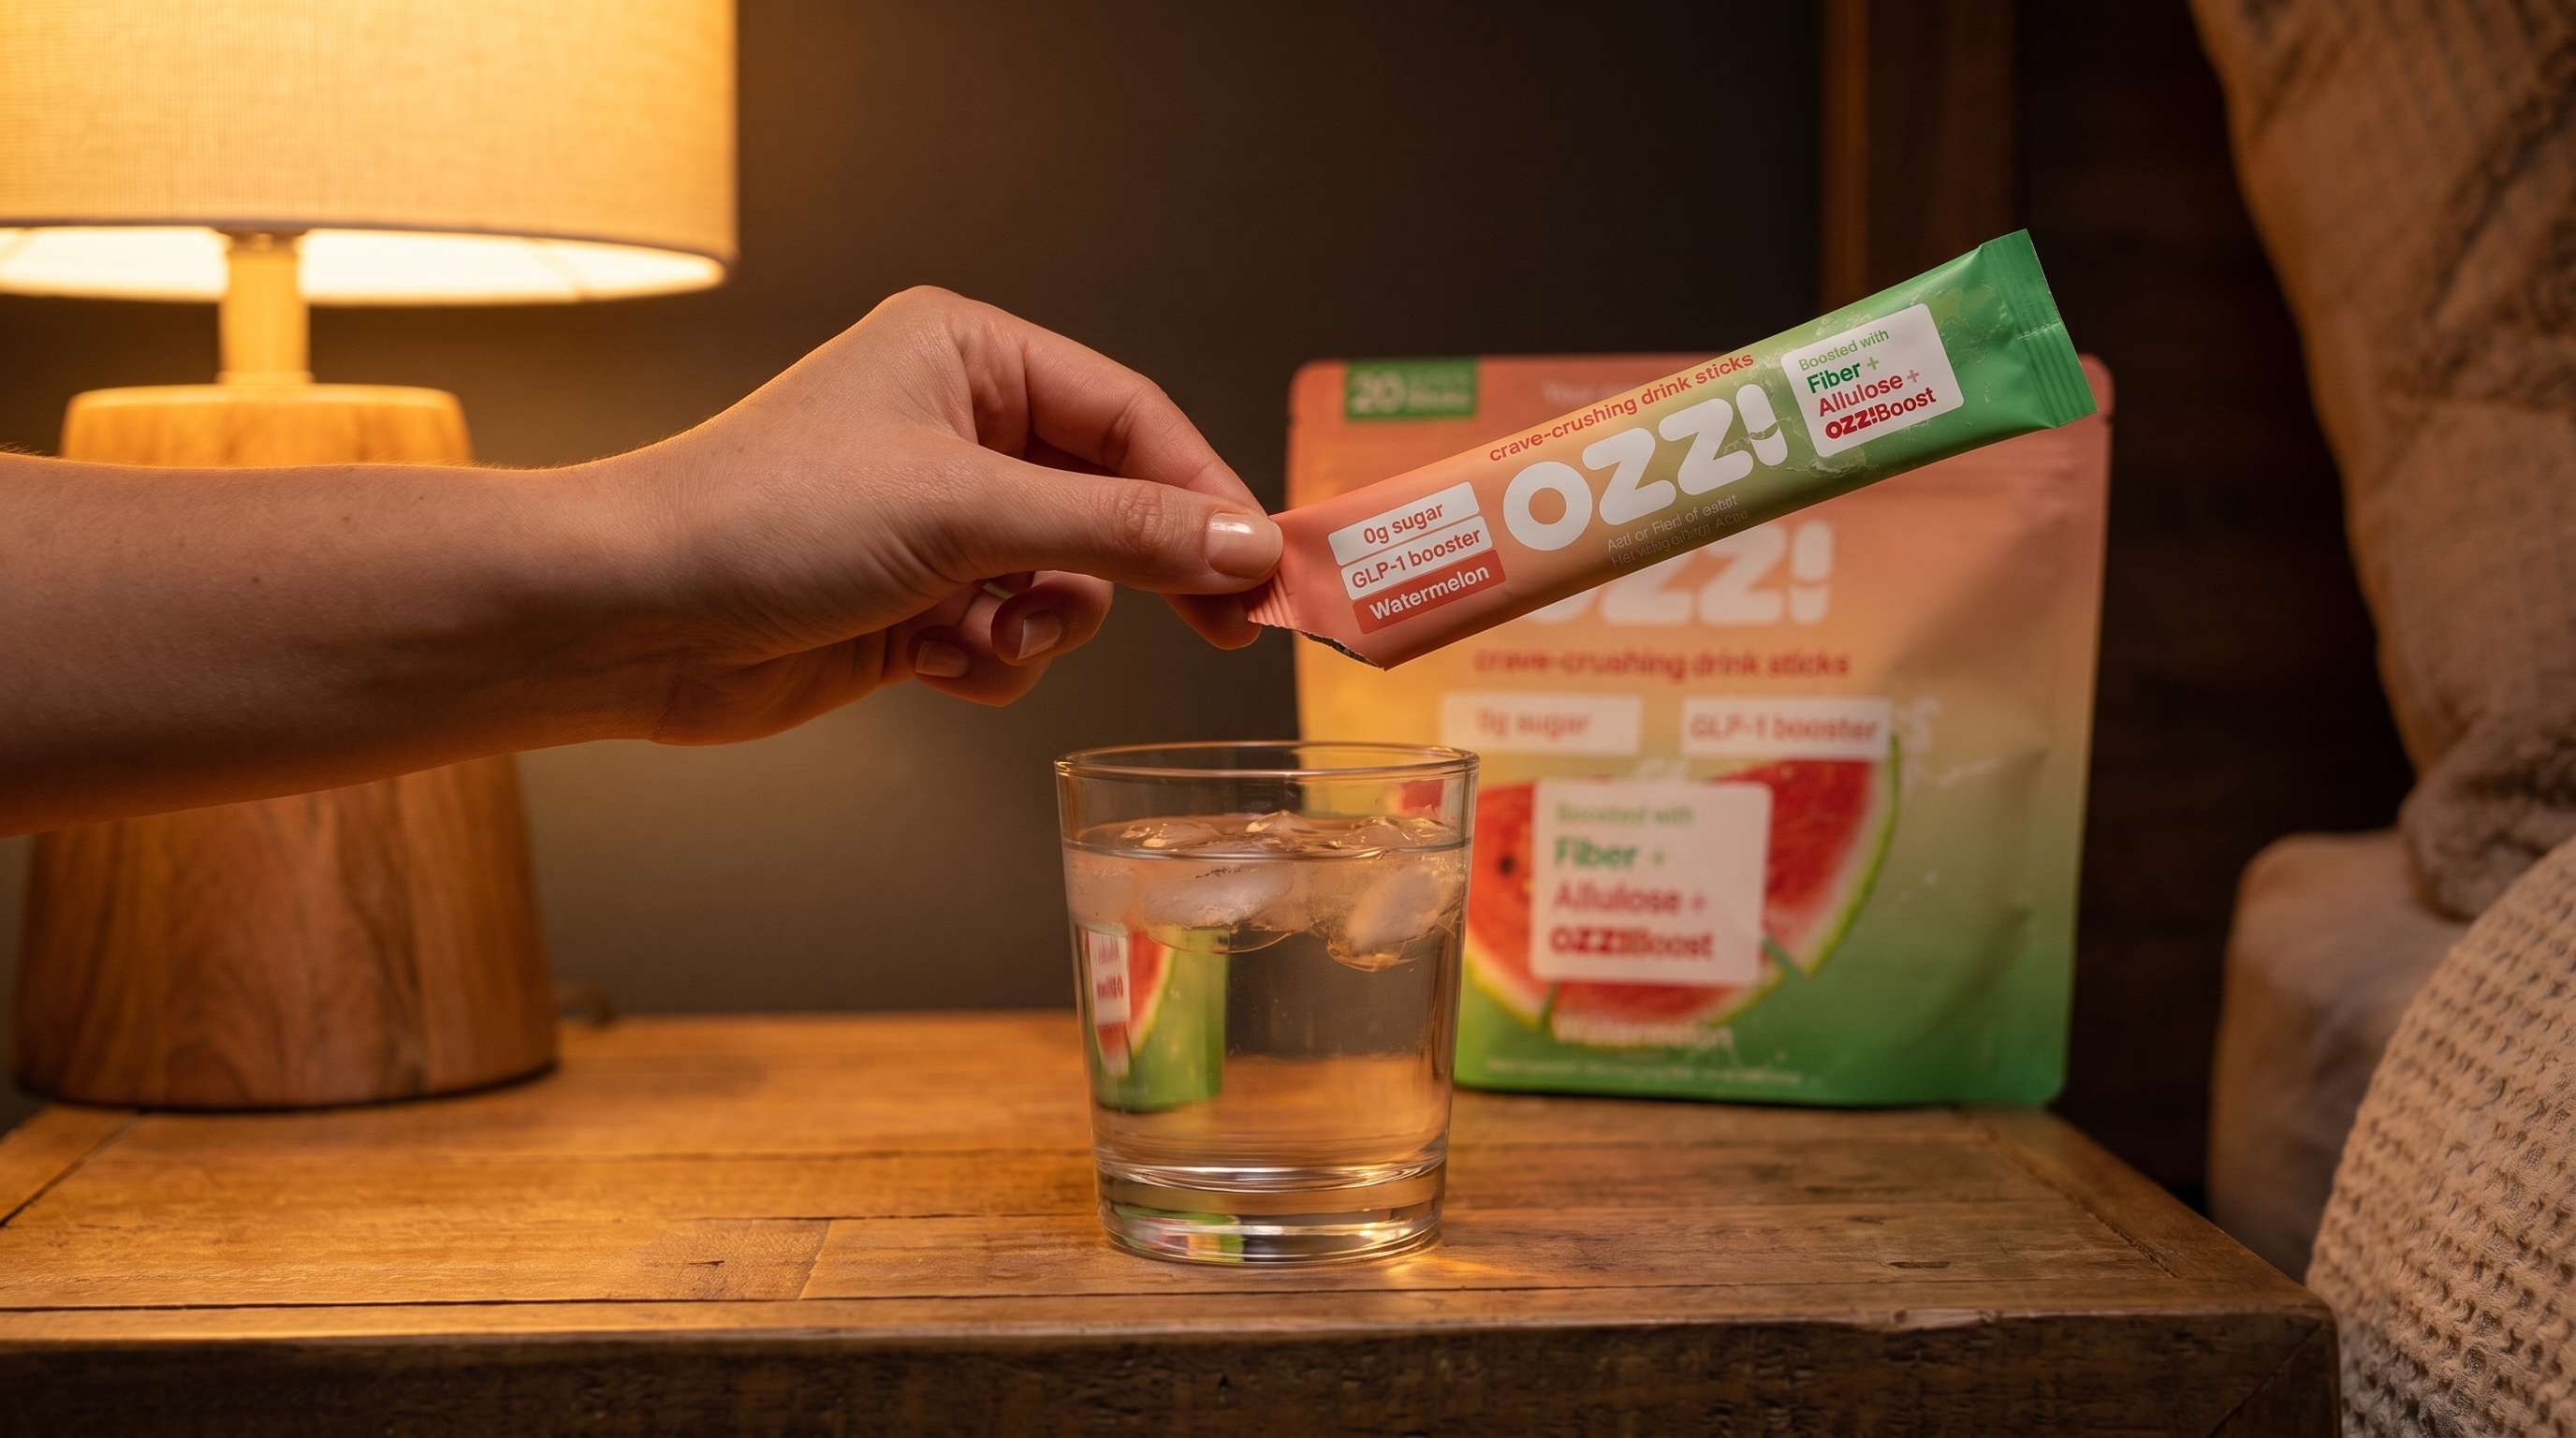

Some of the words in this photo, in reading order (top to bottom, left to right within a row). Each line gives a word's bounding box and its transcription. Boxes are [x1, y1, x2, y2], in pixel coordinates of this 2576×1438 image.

[1798, 340, 1858, 372] Boosted
[1859, 330, 1890, 348] with
[1807, 362, 1861, 393] Fiber
[1819, 374, 1904, 418] Allulose
[1488, 398, 1638, 462] crave-crushing
[1641, 376, 1692, 405] drink
[1695, 354, 1754, 385] sticks
[1502, 383, 1788, 551] OZZ!
[1363, 525, 1390, 544] 0g
[1391, 504, 1443, 535] sugar
[1352, 554, 1407, 589] GLP-1
[1408, 529, 1481, 567] booster
[1521, 520, 1835, 625] ZZ!
[1368, 565, 1490, 621] Watermelon
[1473, 650, 1686, 682] crave-crushing
[1692, 651, 1759, 678] drink
[1768, 653, 1850, 678] sticks
